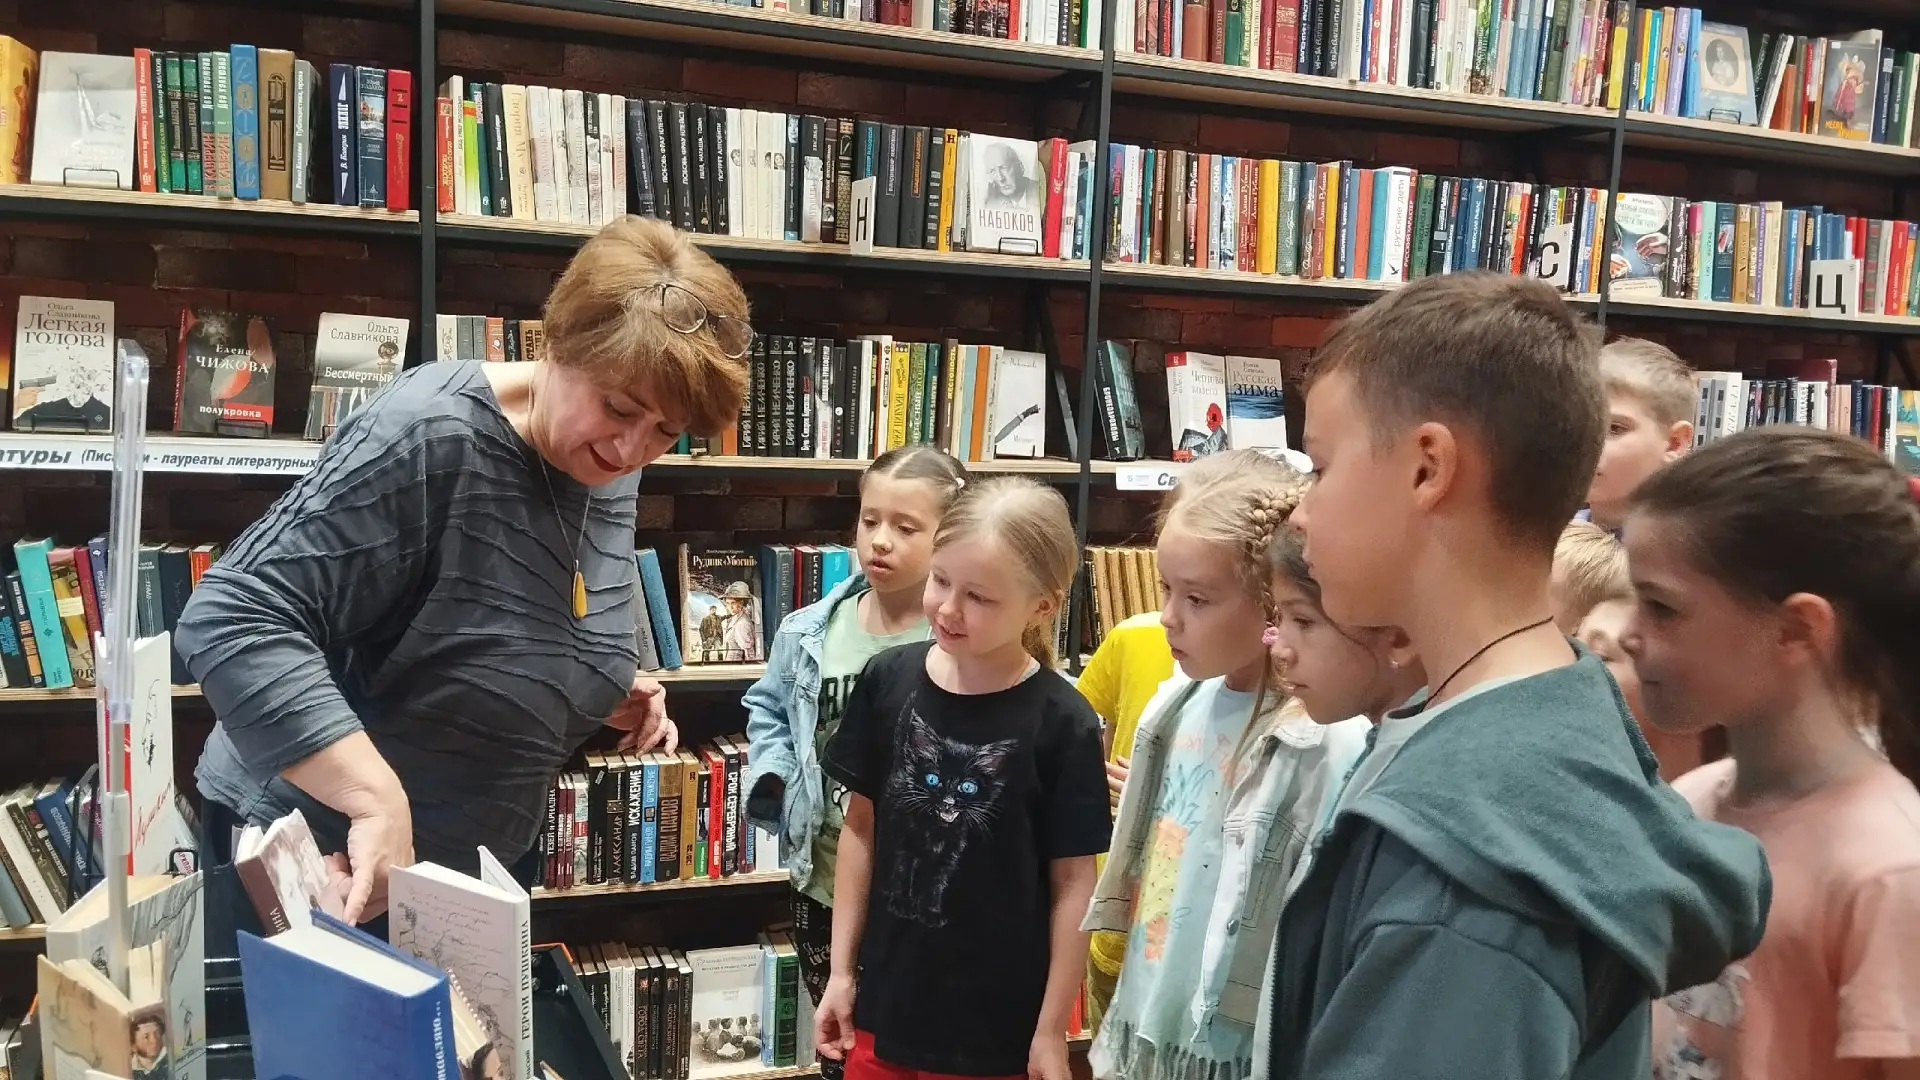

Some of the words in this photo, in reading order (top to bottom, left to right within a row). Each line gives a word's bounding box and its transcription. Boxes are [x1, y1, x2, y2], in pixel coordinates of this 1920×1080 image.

[656, 109, 665, 135] КЛЕЙСТ
[678, 110, 686, 136] КЛЕЙСТ
[202, 132, 216, 181] КАВЕРИН
[218, 132, 230, 180] КАВЕРИН
[658, 136, 667, 154] ФРАУ
[679, 138, 688, 155] ФРАУ
[661, 154, 669, 184] ЛЮБОВЬ
[681, 155, 689, 185] ЛЮБОВЬ
[716, 156, 725, 182] ПОРТРЕТ
[1212, 164, 1221, 193] ОКНА
[855, 197, 869, 242] Н
[978, 208, 1035, 234] НАБОКОВ
[1404, 200, 1414, 235] ХАРАКТЕР
[1402, 234, 1411, 268] РУССКИЙ
[1538, 242, 1560, 279] С
[47, 303, 75, 312] Ольга
[1815, 273, 1847, 315] Ц
[24, 313, 106, 334] Легкая
[47, 310, 101, 321] Славникова
[366, 320, 401, 336] Ольга
[25, 331, 105, 348] голова
[215, 343, 251, 356] Елена
[330, 327, 400, 345] Славникова
[195, 355, 270, 377] ЧИЖОВА
[323, 365, 395, 384] Бессмертный
[946, 346, 957, 400] ЖЕСТОКОСТЬ
[1232, 370, 1277, 385] Русская
[756, 361, 767, 418] НЕМЧЕНКО
[772, 359, 782, 416] НЕМЧЕНКО
[785, 359, 795, 416] НЕМЧЕНКО
[199, 404, 262, 418] полукровка
[756, 420, 767, 450] ГАРИЙ
[772, 419, 781, 446] ГАРИЙ
[785, 417, 795, 446] ГАРИЙ
[161, 453, 224, 468] лауреаты
[226, 456, 318, 471] литературных
[692, 555, 723, 571] Рудник
[727, 771, 739, 795] СРОК
[548, 788, 556, 825] АРИАДНА
[627, 769, 642, 827] ИСКАЖЕНИЕ
[660, 798, 679, 833] ПАНОВ
[725, 795, 738, 852] СЕРЕБРЯНЫЙ
[546, 832, 555, 856] ТЕЗЕЙ
[630, 832, 638, 855] ПАНОВ
[659, 835, 673, 862] ВАДИМ
[629, 855, 638, 880] ВАДИМ
[520, 920, 529, 993] ПУШКИНА
[521, 996, 530, 1042] ГЕРОИ
